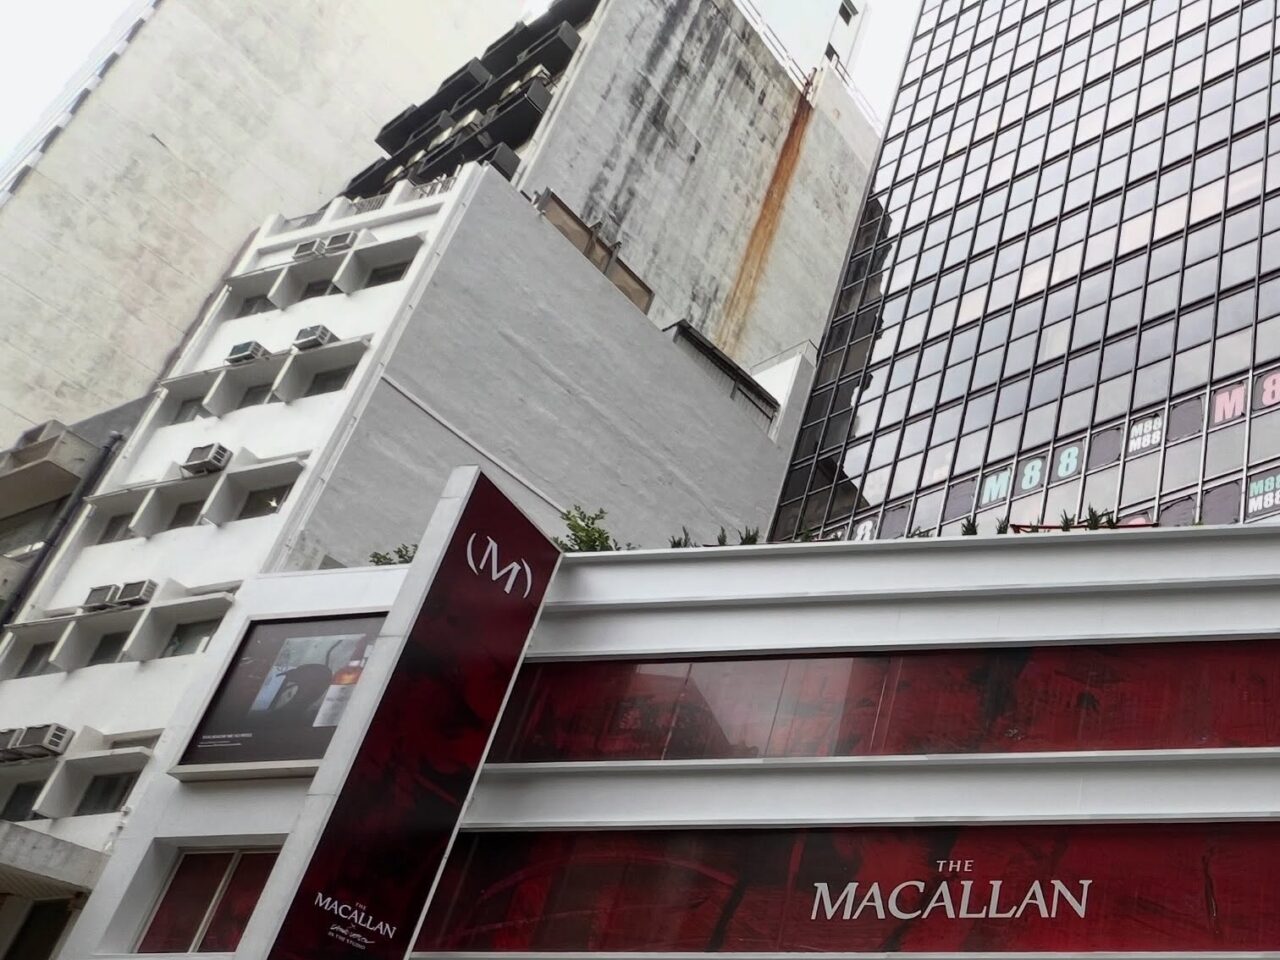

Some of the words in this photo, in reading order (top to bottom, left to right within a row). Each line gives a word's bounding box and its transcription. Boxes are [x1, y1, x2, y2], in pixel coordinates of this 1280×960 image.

[936, 860, 974, 872] THE
[315, 892, 397, 938] MACALLAN
[811, 880, 1092, 920] MACALLAN
